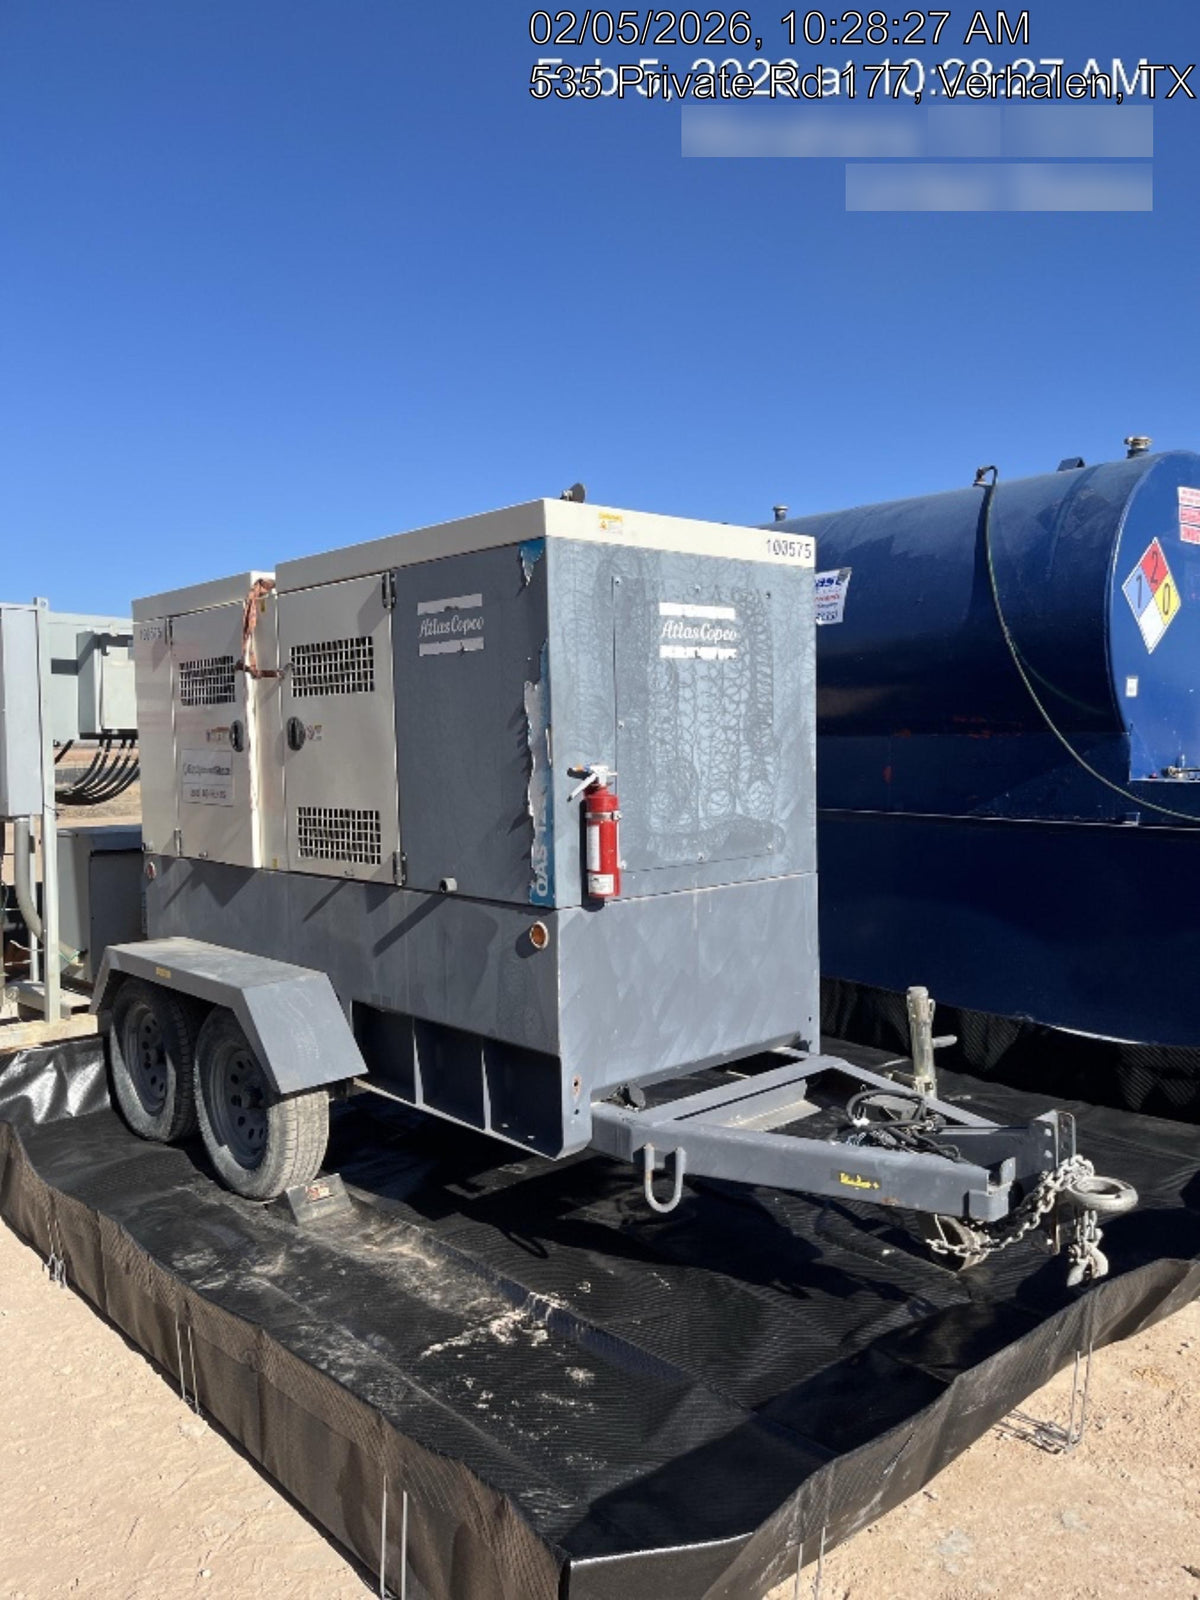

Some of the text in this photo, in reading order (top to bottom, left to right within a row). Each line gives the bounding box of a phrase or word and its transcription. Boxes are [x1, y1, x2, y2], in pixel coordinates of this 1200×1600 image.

[1150, 550, 1158, 583] 2
[1136, 574, 1170, 615] 1 0
[419, 614, 485, 637] Atlas Copco
[660, 620, 737, 645] Atlas Copco
